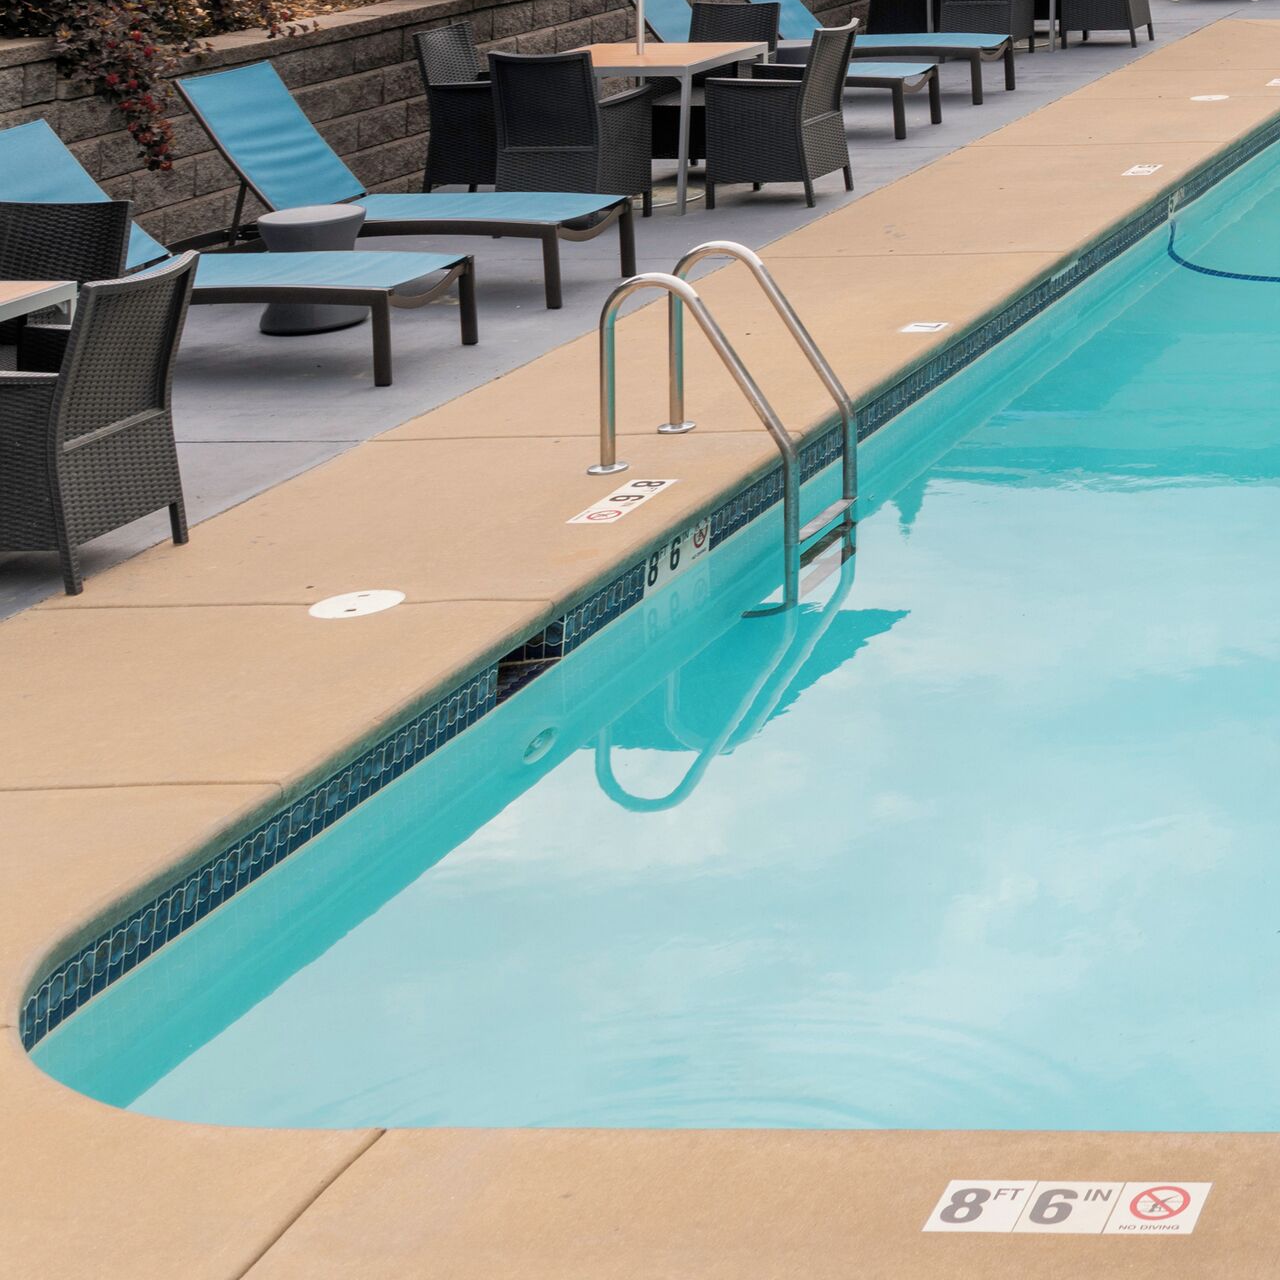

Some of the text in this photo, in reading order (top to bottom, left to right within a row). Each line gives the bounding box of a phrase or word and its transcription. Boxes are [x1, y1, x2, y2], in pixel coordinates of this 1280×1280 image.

[647, 551, 659, 587] 8
[669, 536, 681, 571] 6
[939, 1187, 1113, 1225] 8 FT 6 IN
